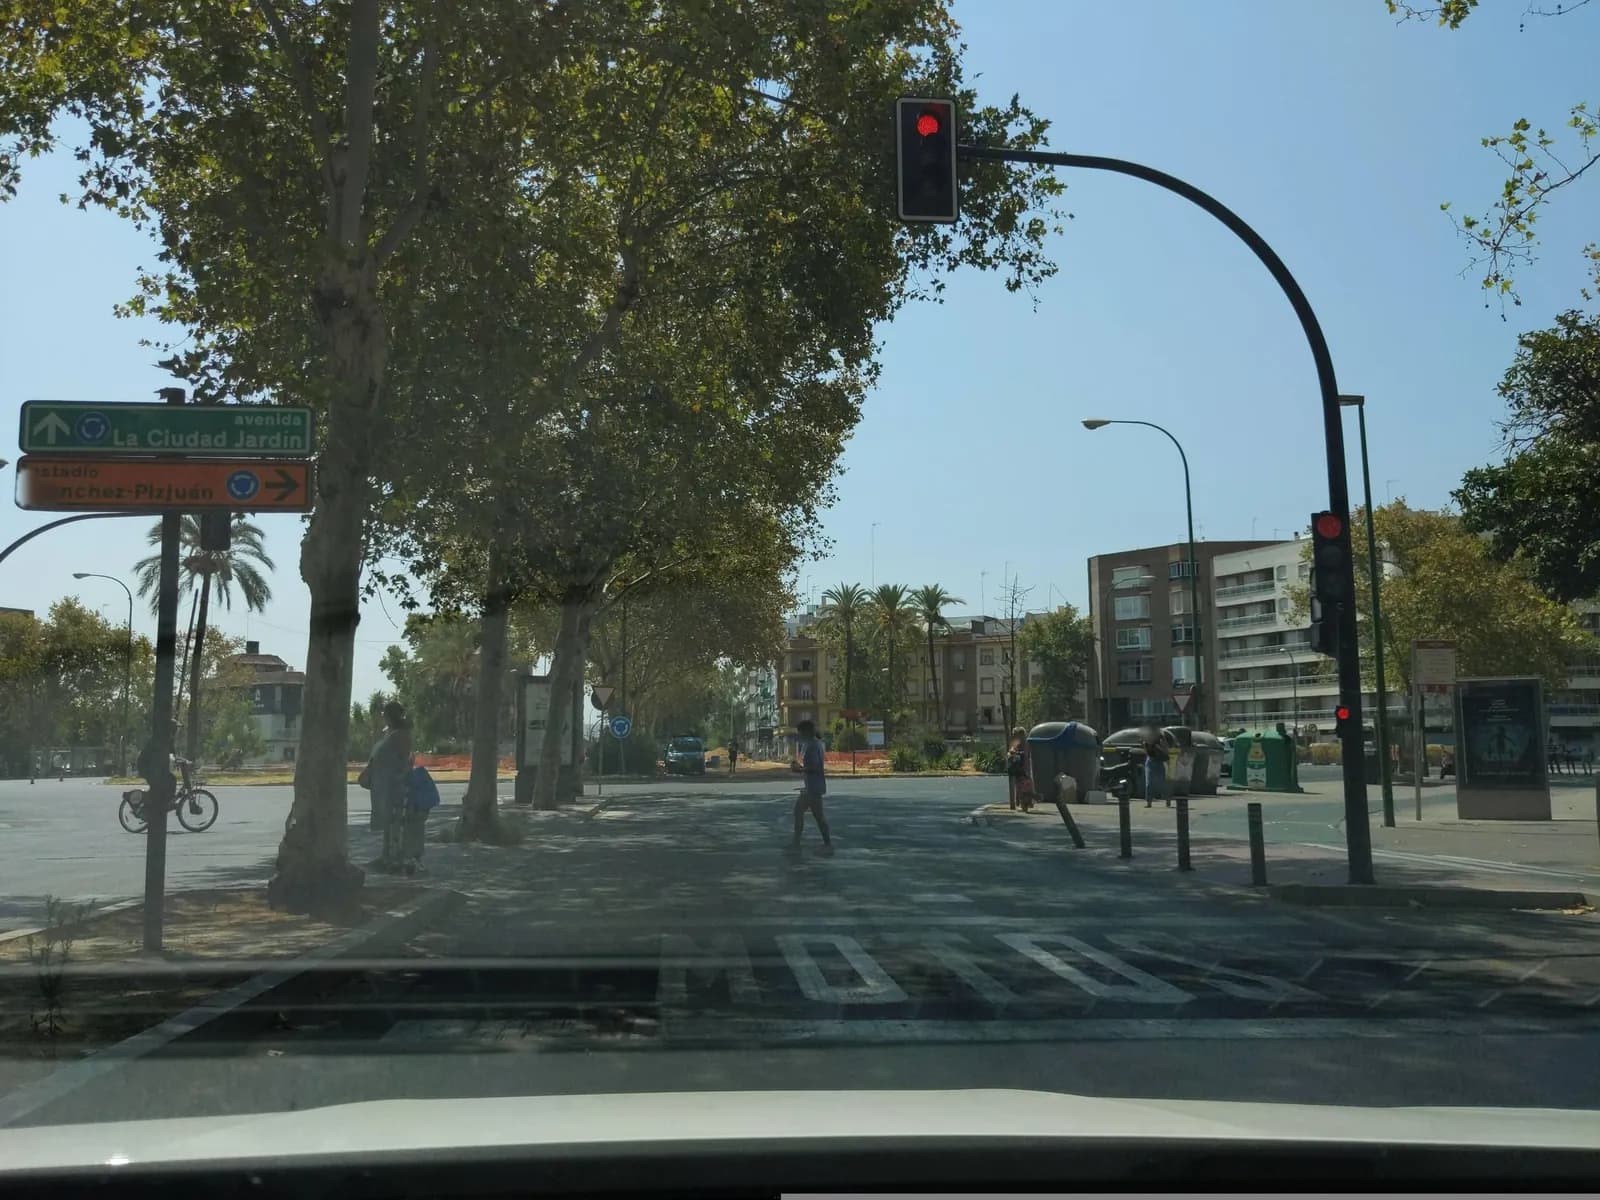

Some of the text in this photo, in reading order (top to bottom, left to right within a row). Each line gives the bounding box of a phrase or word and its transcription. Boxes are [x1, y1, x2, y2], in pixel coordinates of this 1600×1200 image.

[233, 412, 302, 426] avenida
[113, 429, 138, 446] La
[147, 429, 227, 448] Ciudad
[58, 482, 214, 501] nchez-Pizjuán
